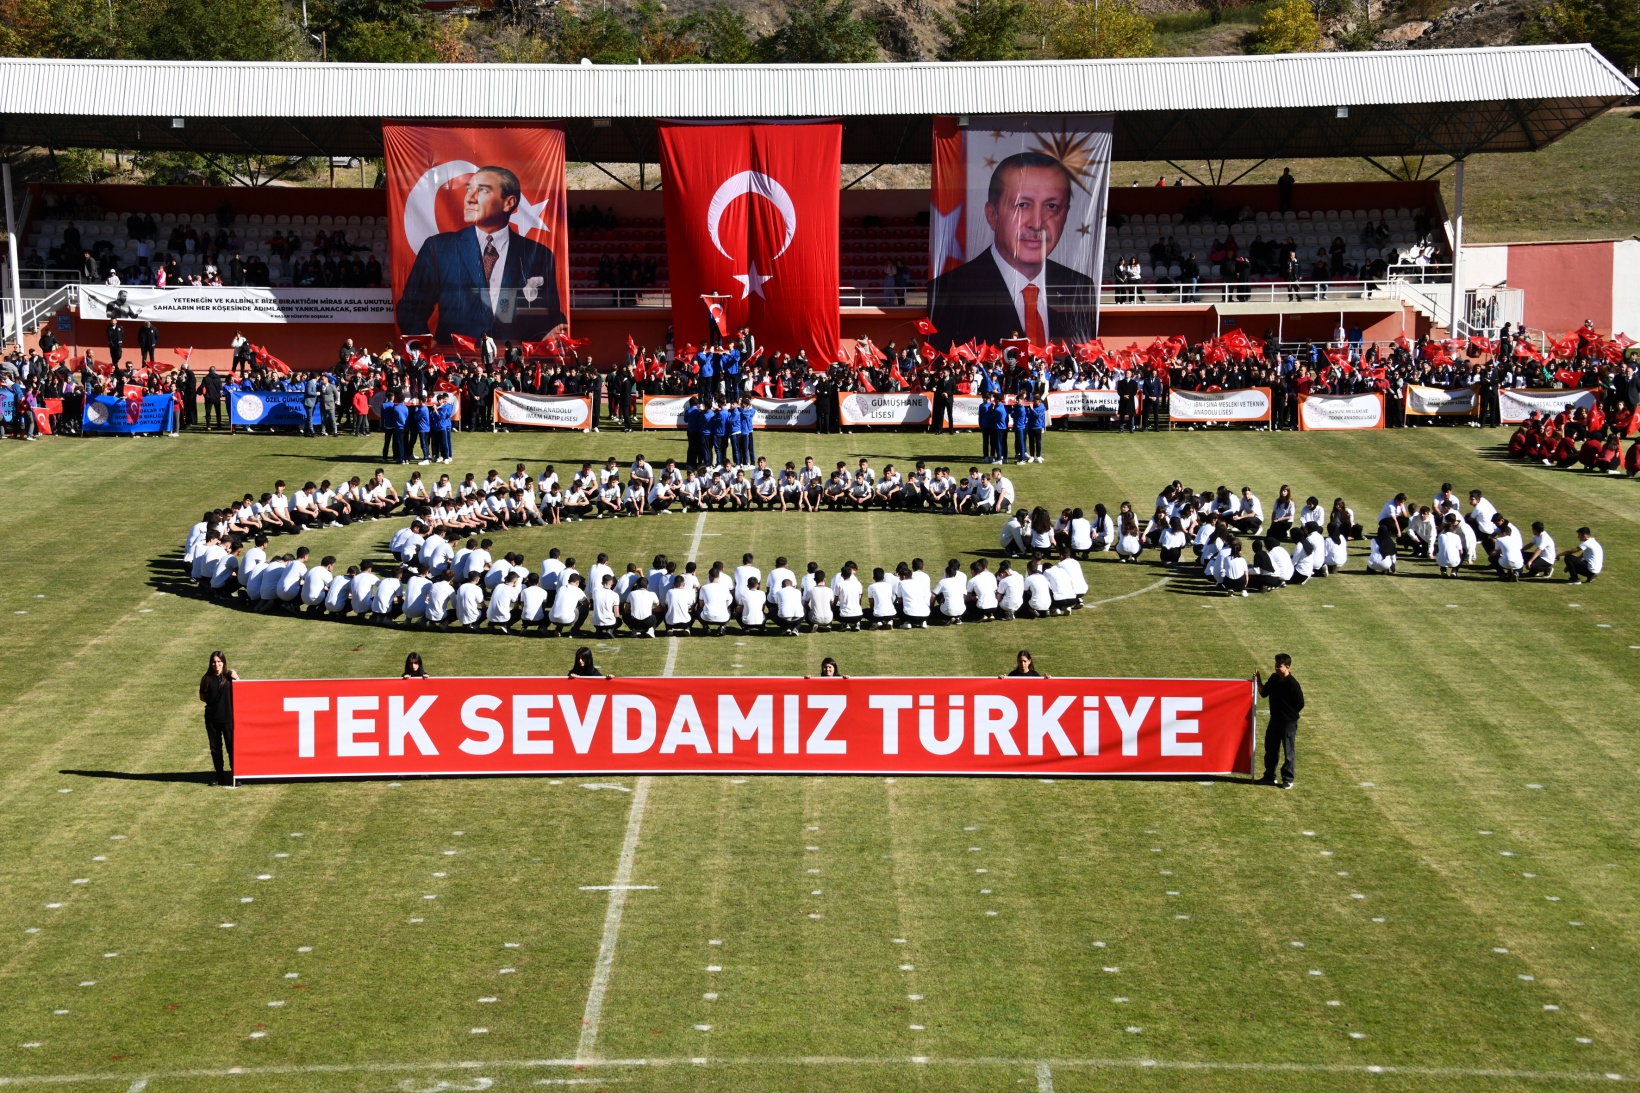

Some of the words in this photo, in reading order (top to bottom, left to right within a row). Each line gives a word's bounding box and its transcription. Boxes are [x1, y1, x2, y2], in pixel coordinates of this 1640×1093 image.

[282, 396, 306, 404] GÜMÜŞ
[872, 398, 922, 408] GÜMÜŞHANE
[283, 696, 440, 758] TEK
[458, 694, 847, 756] SEVDAMIZ
[868, 694, 1203, 756] TÜRKİYE
